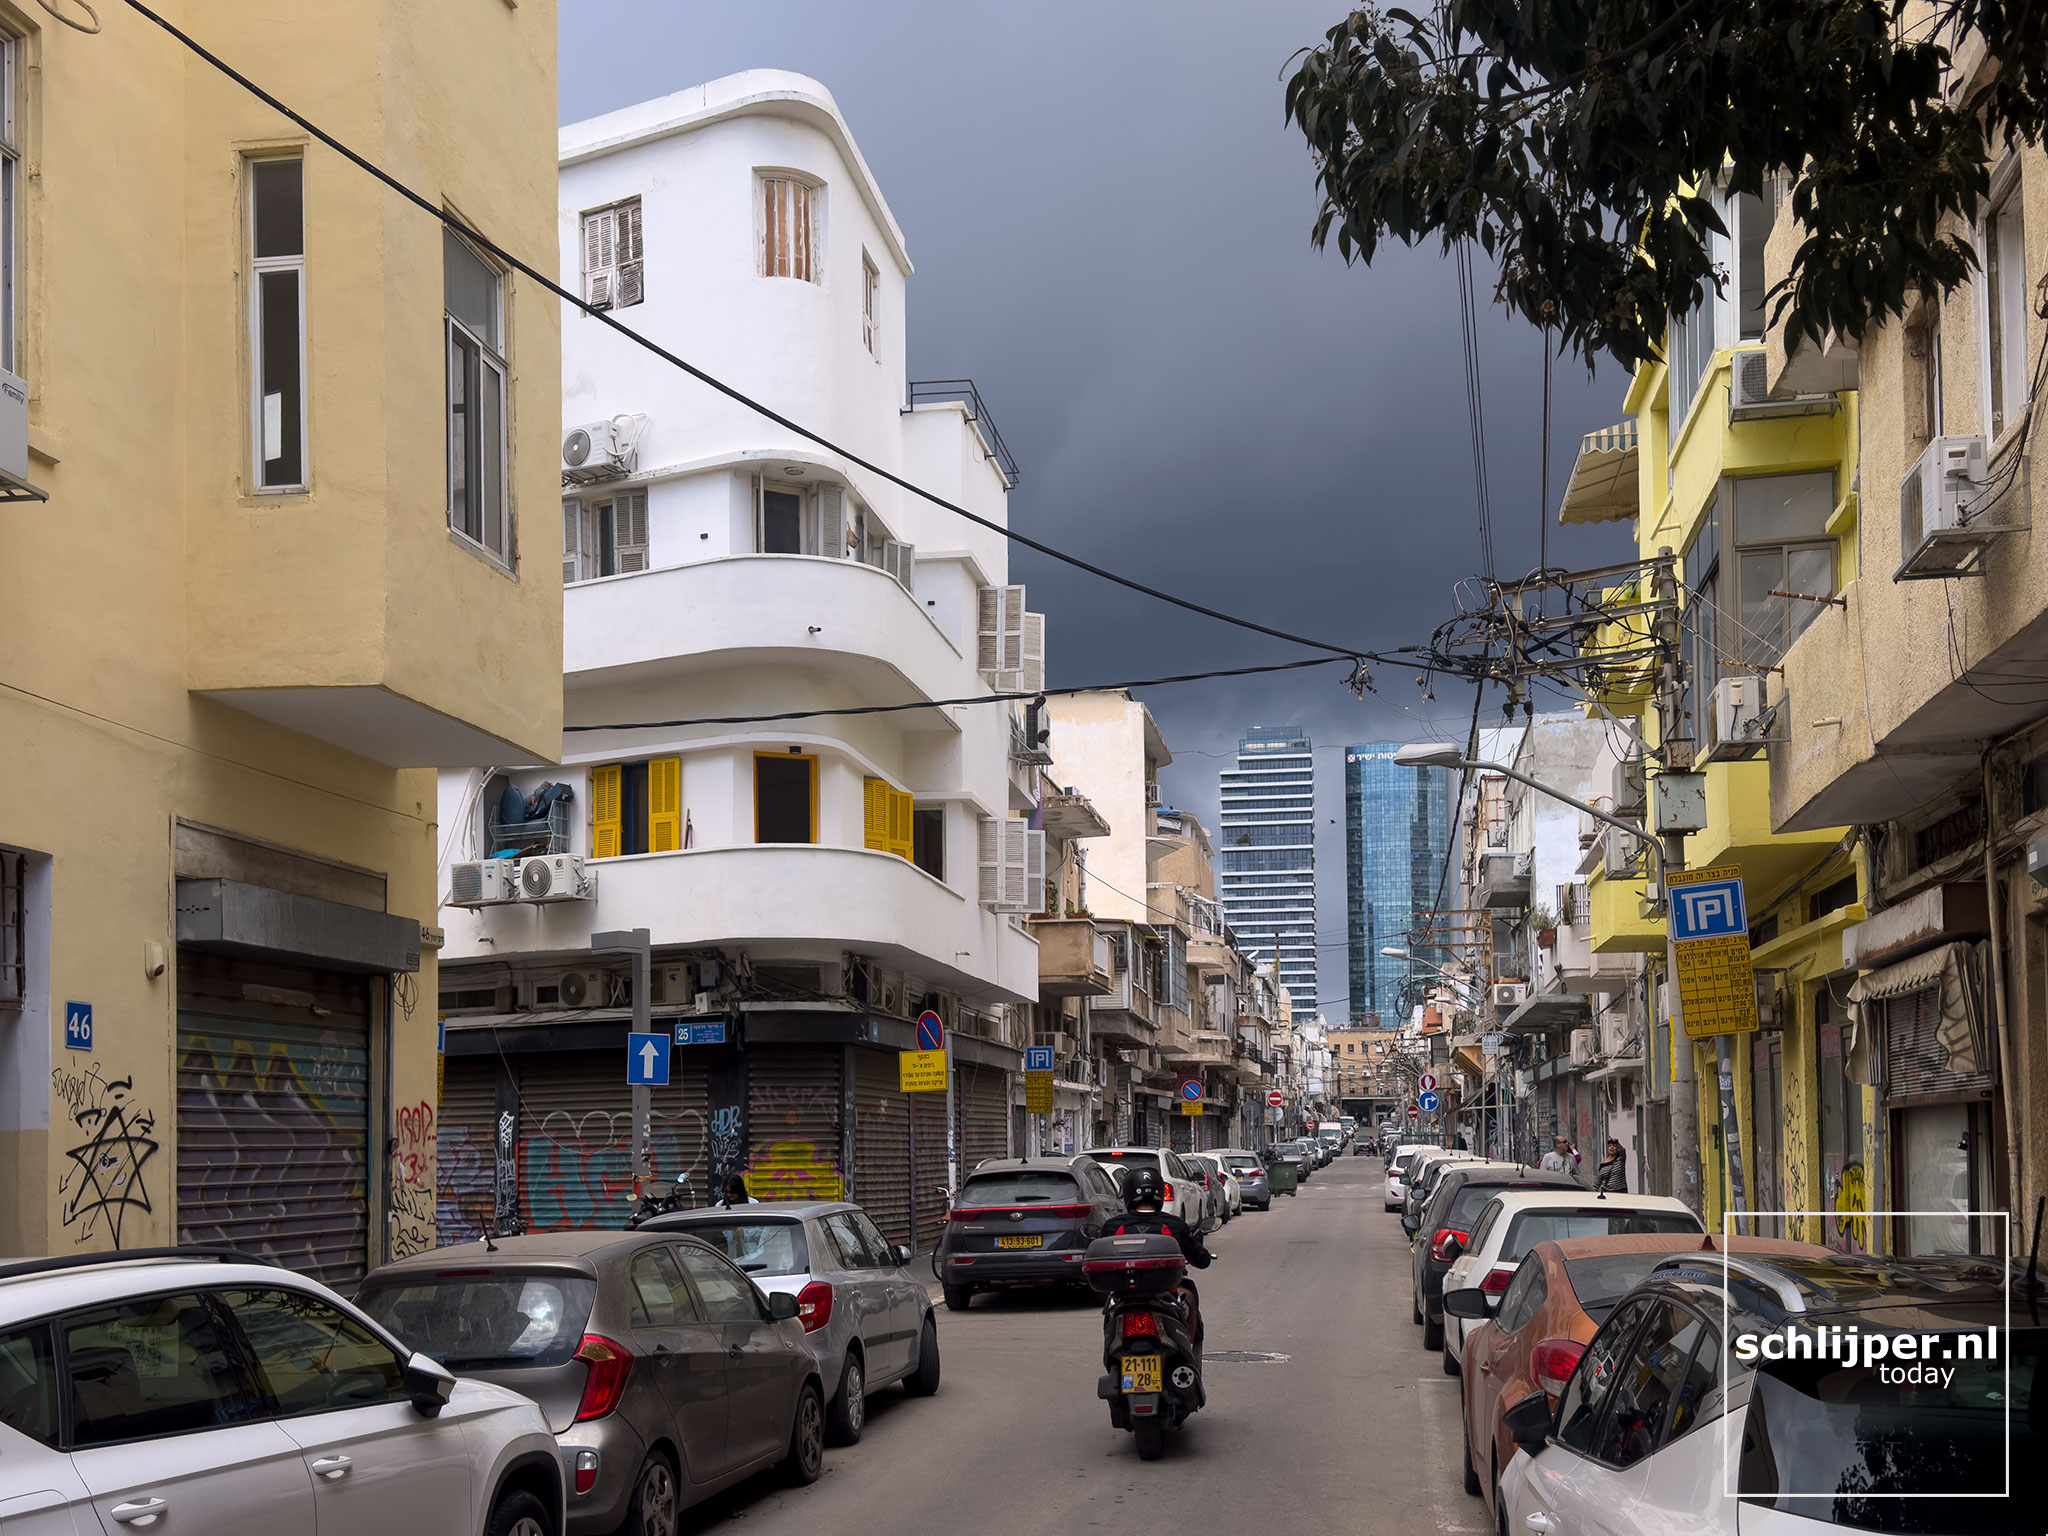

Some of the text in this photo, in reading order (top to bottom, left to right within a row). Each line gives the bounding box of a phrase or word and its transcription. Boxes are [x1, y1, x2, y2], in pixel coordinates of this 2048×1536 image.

[1723, 868, 1738, 876] חניה
[69, 1012, 90, 1040] 46
[678, 1028, 688, 1040] 25
